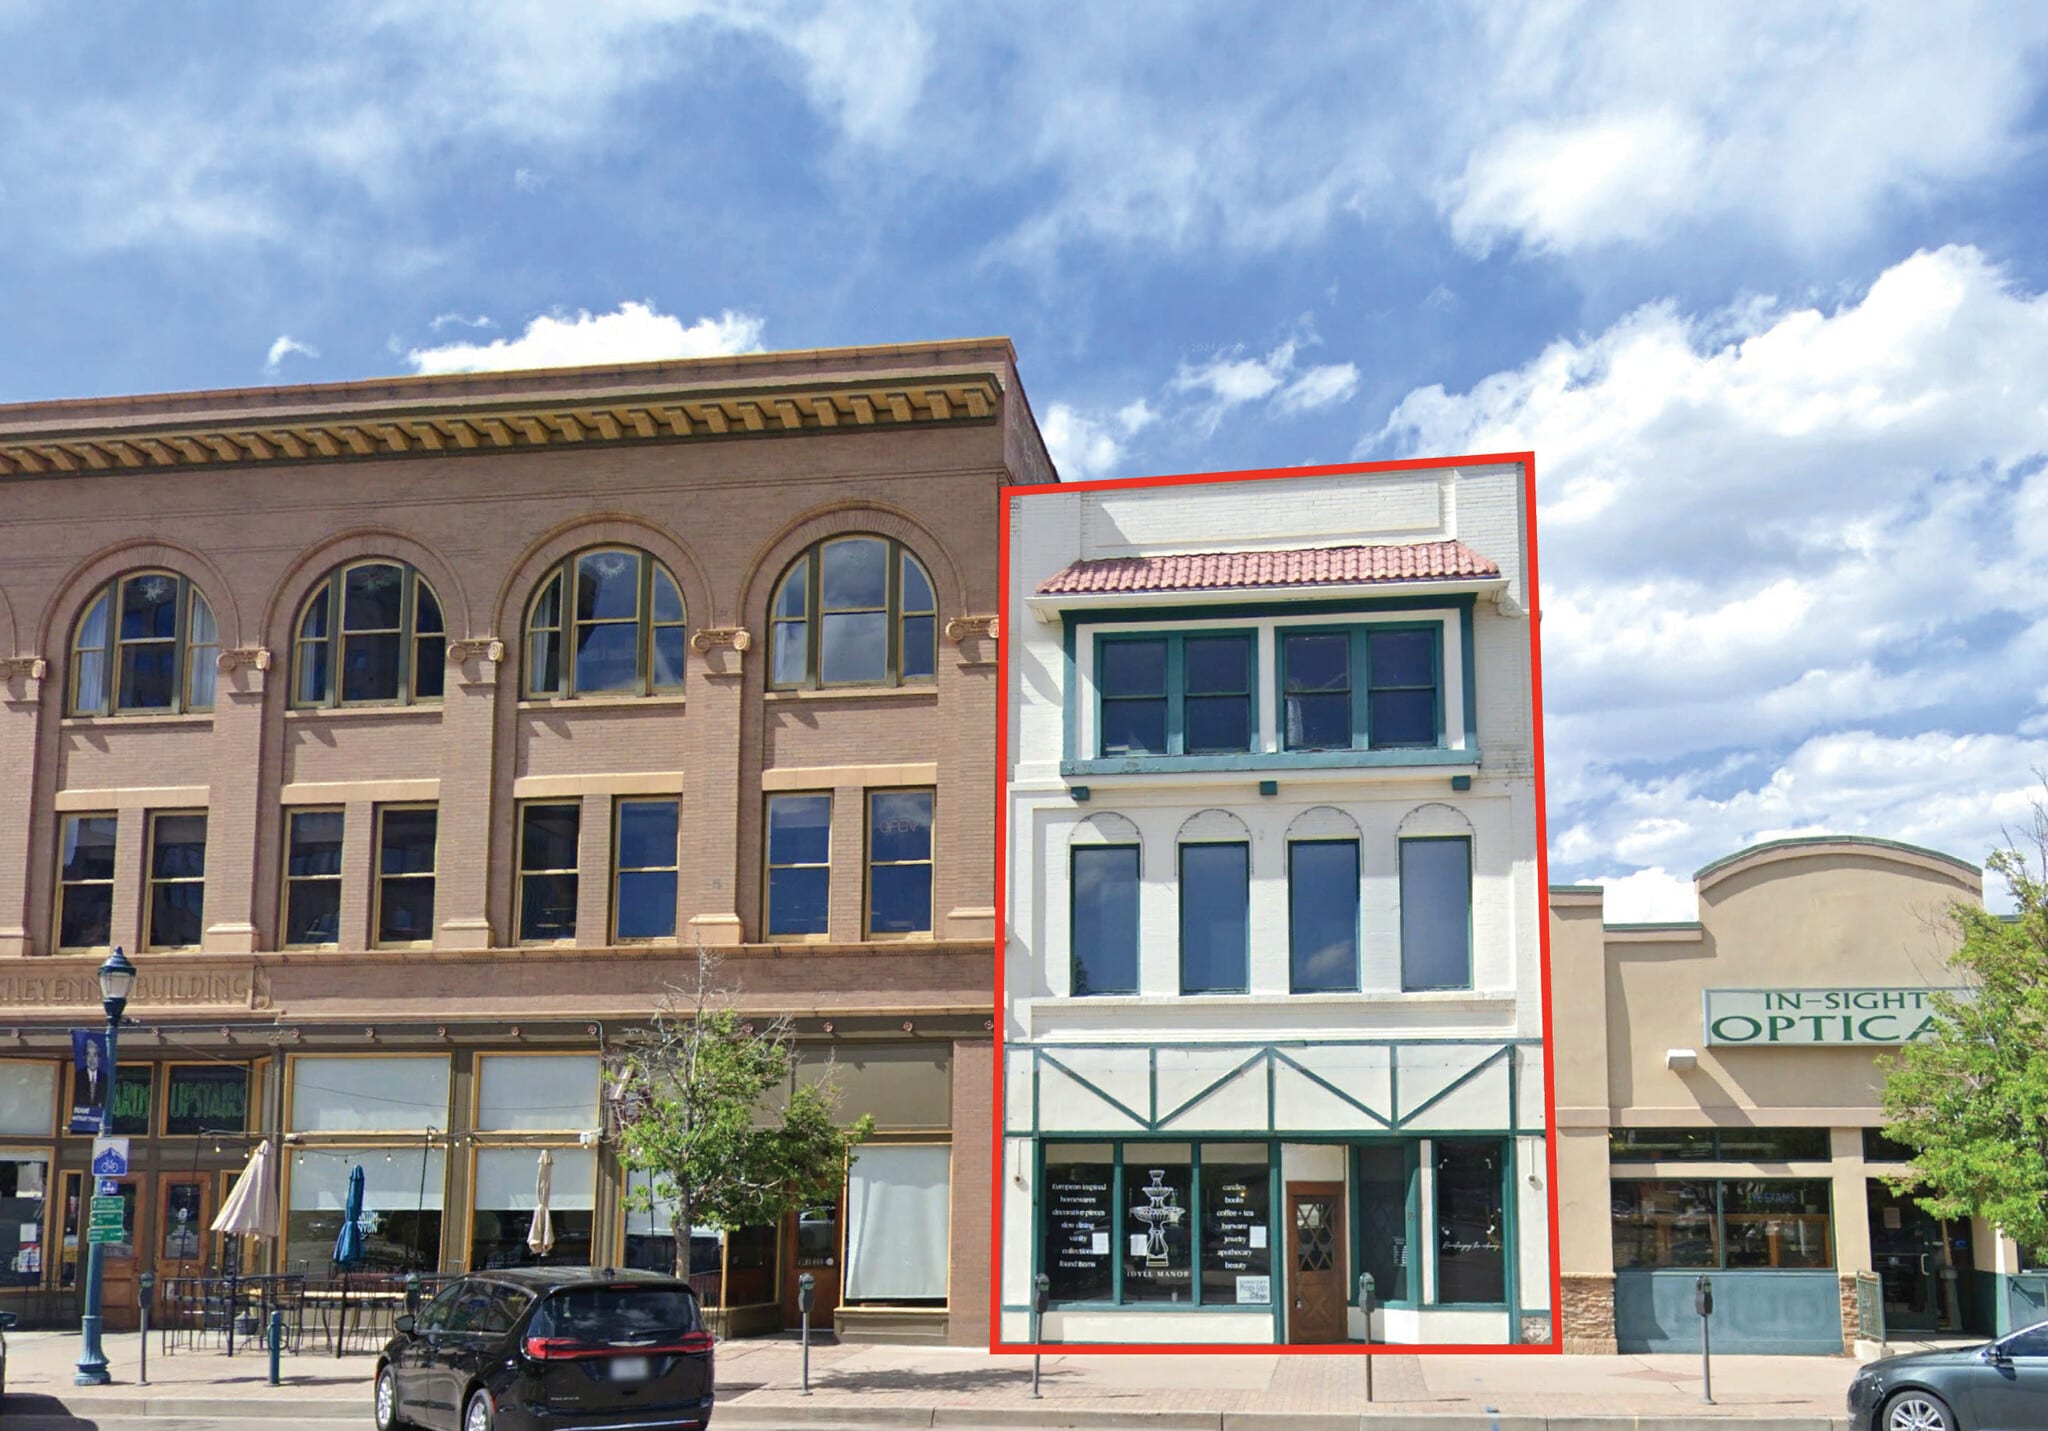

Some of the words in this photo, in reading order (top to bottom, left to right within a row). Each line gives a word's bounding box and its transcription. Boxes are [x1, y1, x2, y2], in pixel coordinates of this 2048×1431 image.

[0, 976, 101, 1001] HEYENN
[135, 973, 247, 999] BUILDING
[1765, 991, 1929, 1010] IN-SIGHT
[1711, 1014, 1937, 1042] OPTICA
[1222, 1183, 1246, 1191] candles
[1060, 1195, 1096, 1203] homewares
[1224, 1196, 1244, 1204] books
[1052, 1208, 1084, 1216] decorative
[1085, 1208, 1106, 1217] pieces
[1216, 1208, 1237, 1217] coffee
[1243, 1209, 1254, 1217] tea
[1076, 1221, 1095, 1230] dining
[1221, 1222, 1248, 1230] barware
[1069, 1234, 1087, 1243] vanity
[1223, 1235, 1247, 1244] jewelry
[1217, 1248, 1252, 1257] apothecary
[1224, 1261, 1247, 1270] beauty
